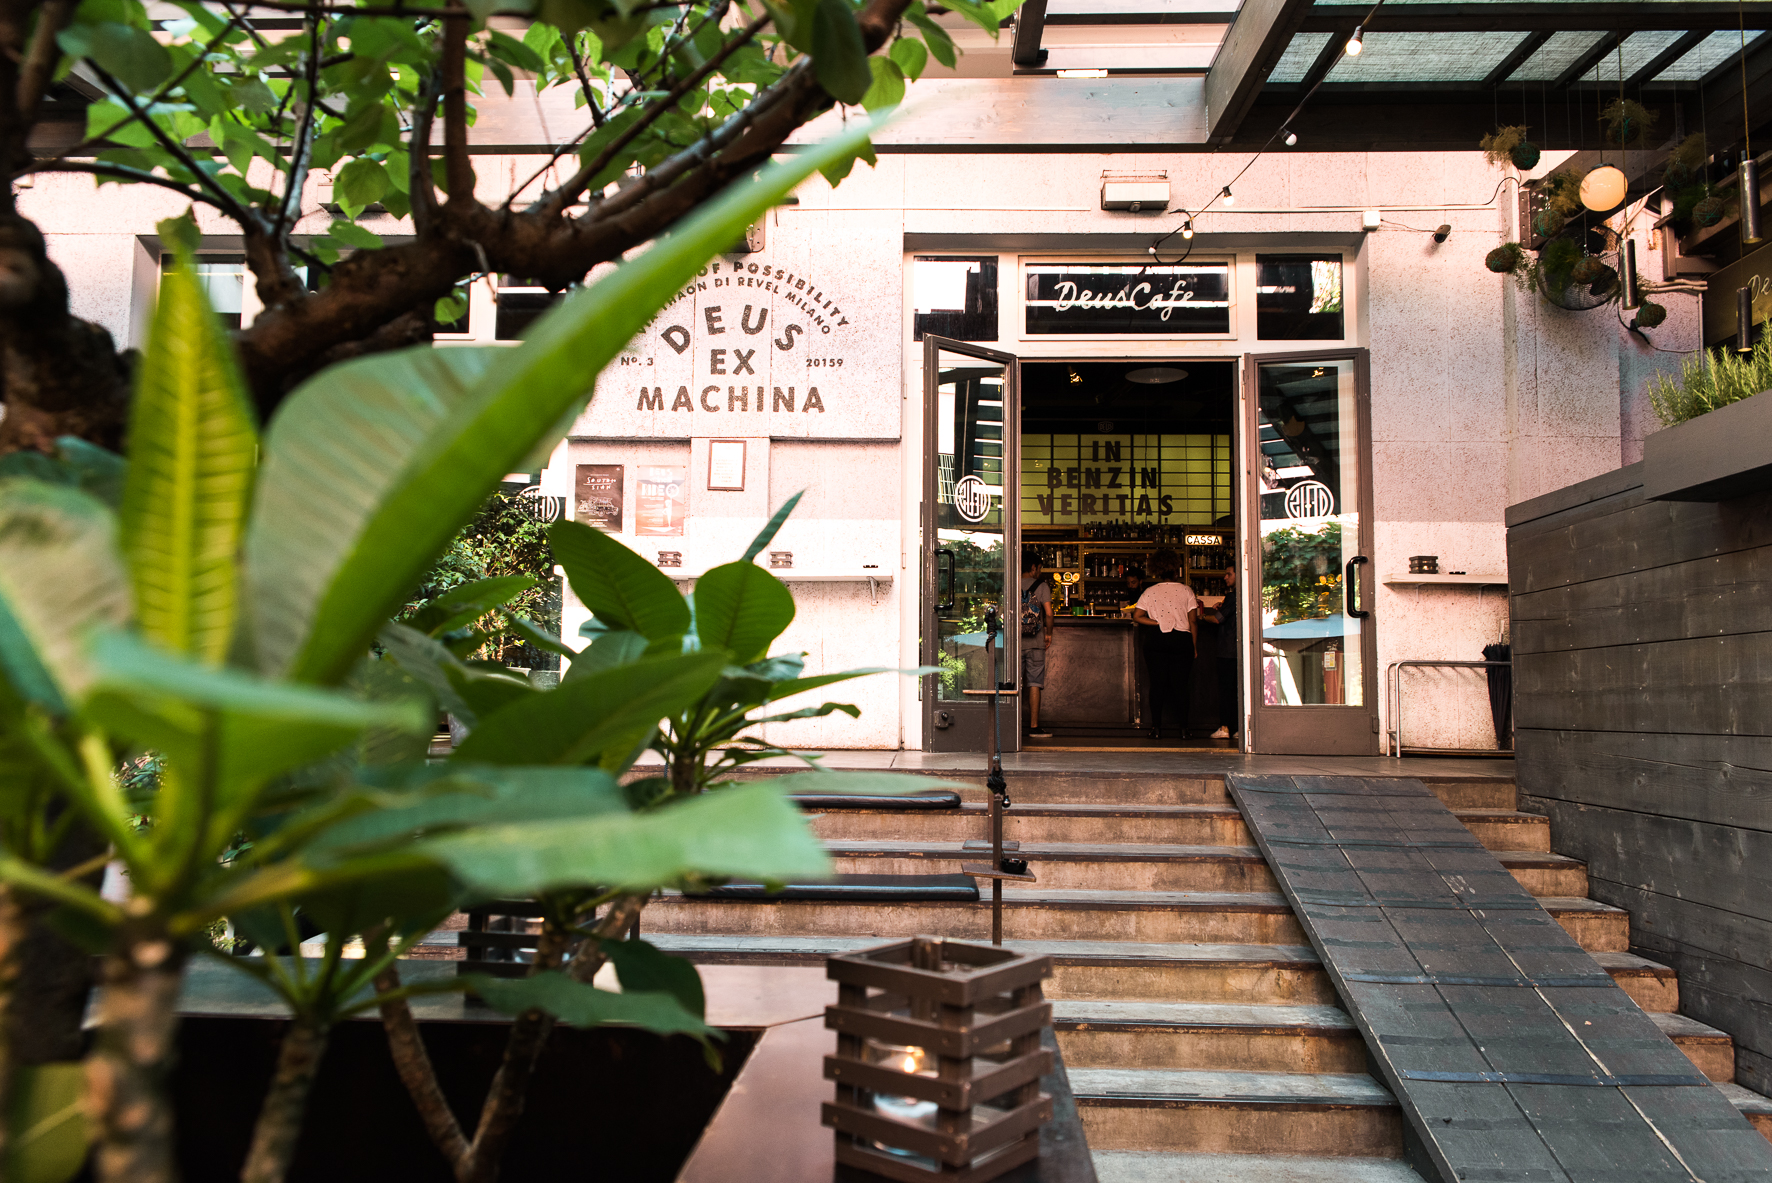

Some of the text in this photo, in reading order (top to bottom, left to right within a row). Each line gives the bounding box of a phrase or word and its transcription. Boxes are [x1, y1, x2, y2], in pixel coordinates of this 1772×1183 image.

[696, 261, 850, 327] OF POSSIBILITY
[714, 276, 730, 288] DI
[737, 276, 779, 294] REVEL
[785, 291, 831, 335] MILANO
[660, 304, 804, 355] DEUS
[646, 357, 654, 366] 3
[710, 348, 756, 375] EX
[805, 358, 844, 367] 20159
[636, 385, 826, 414] MACHINA
[1092, 440, 1121, 462] IN
[1047, 466, 1157, 489] BENZIN
[1036, 493, 1174, 516] VERITAS
[1186, 535, 1221, 545] CASSA
